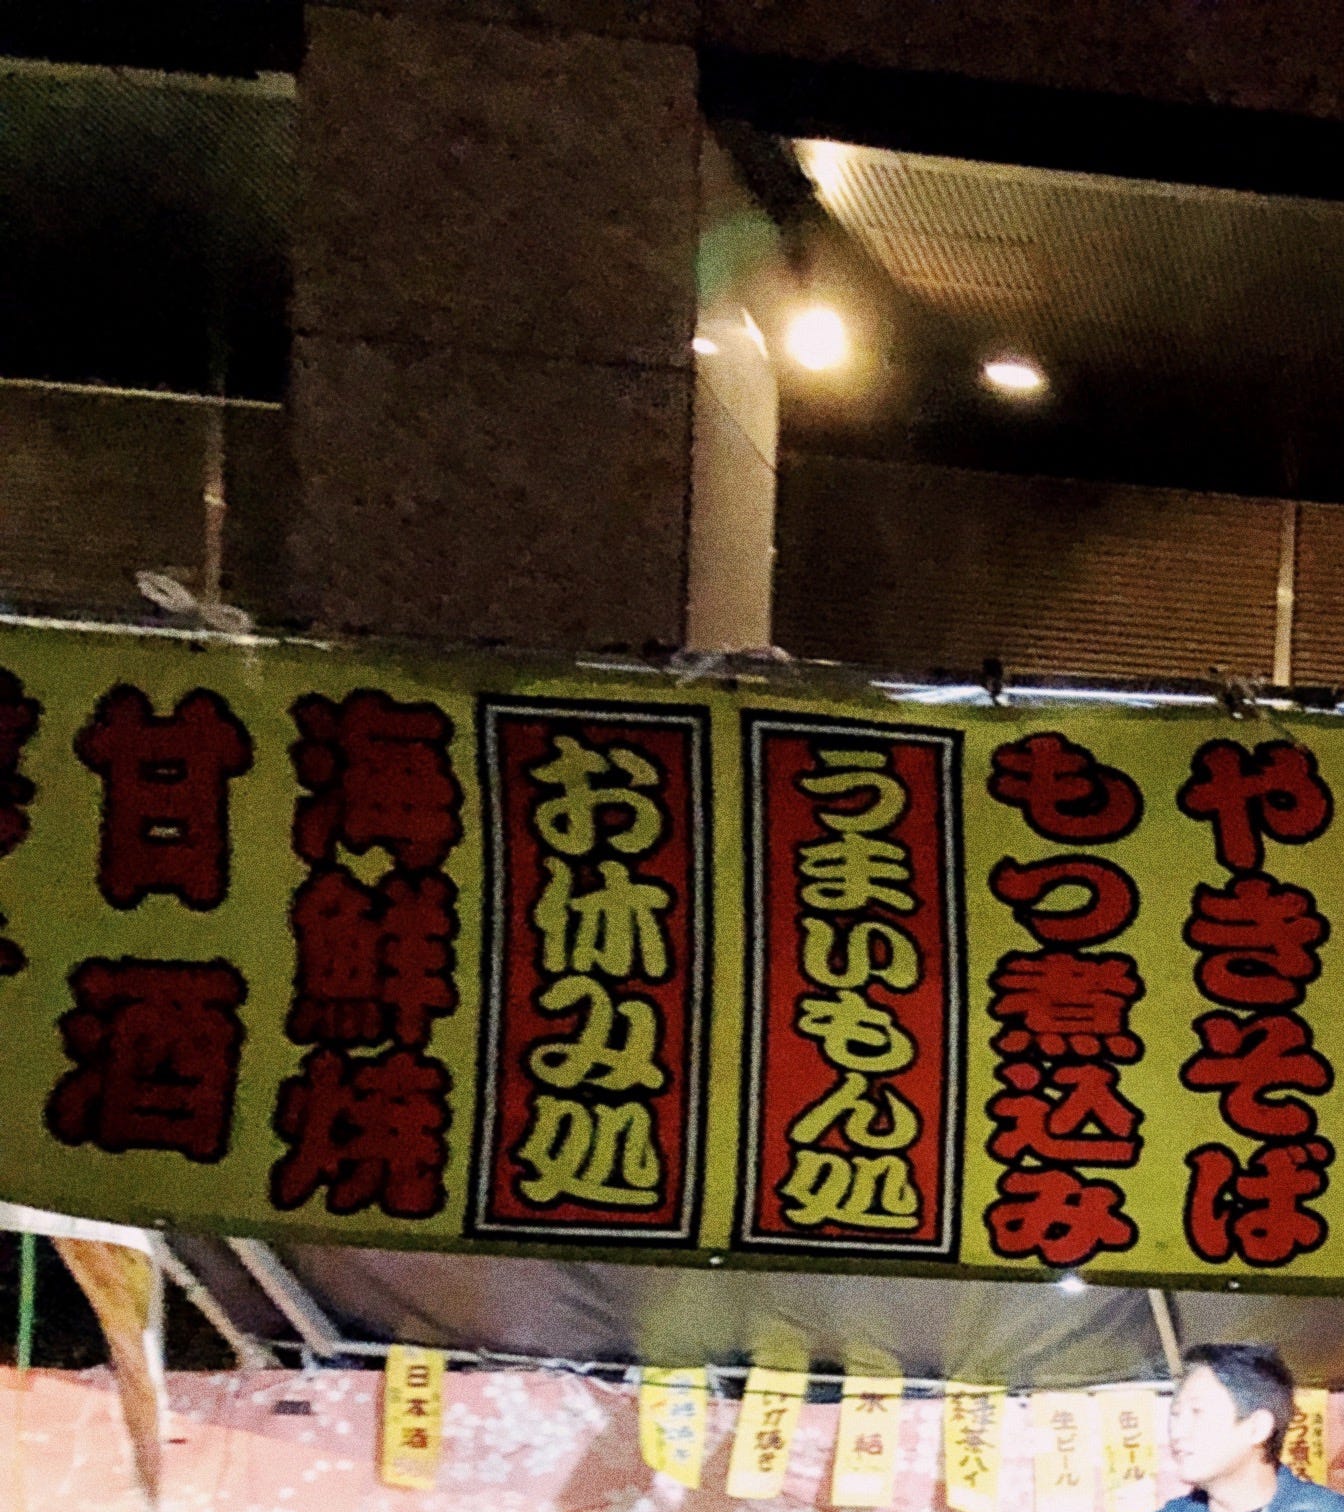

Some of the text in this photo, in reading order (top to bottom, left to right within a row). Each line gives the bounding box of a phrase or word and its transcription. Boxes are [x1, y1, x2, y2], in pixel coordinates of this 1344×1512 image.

[43, 682, 256, 1164] 甘酒
[270, 687, 465, 1219] 海鮮焼
[516, 733, 673, 1209] お休み処
[777, 747, 923, 1231] うまいもん処
[982, 730, 1146, 1269] もつ煮込み
[1177, 737, 1334, 1269] やきそば
[400, 1363, 431, 1449] 日本酒
[1049, 1407, 1081, 1488] 生ビール
[1117, 1408, 1147, 1483] 缶ビール
